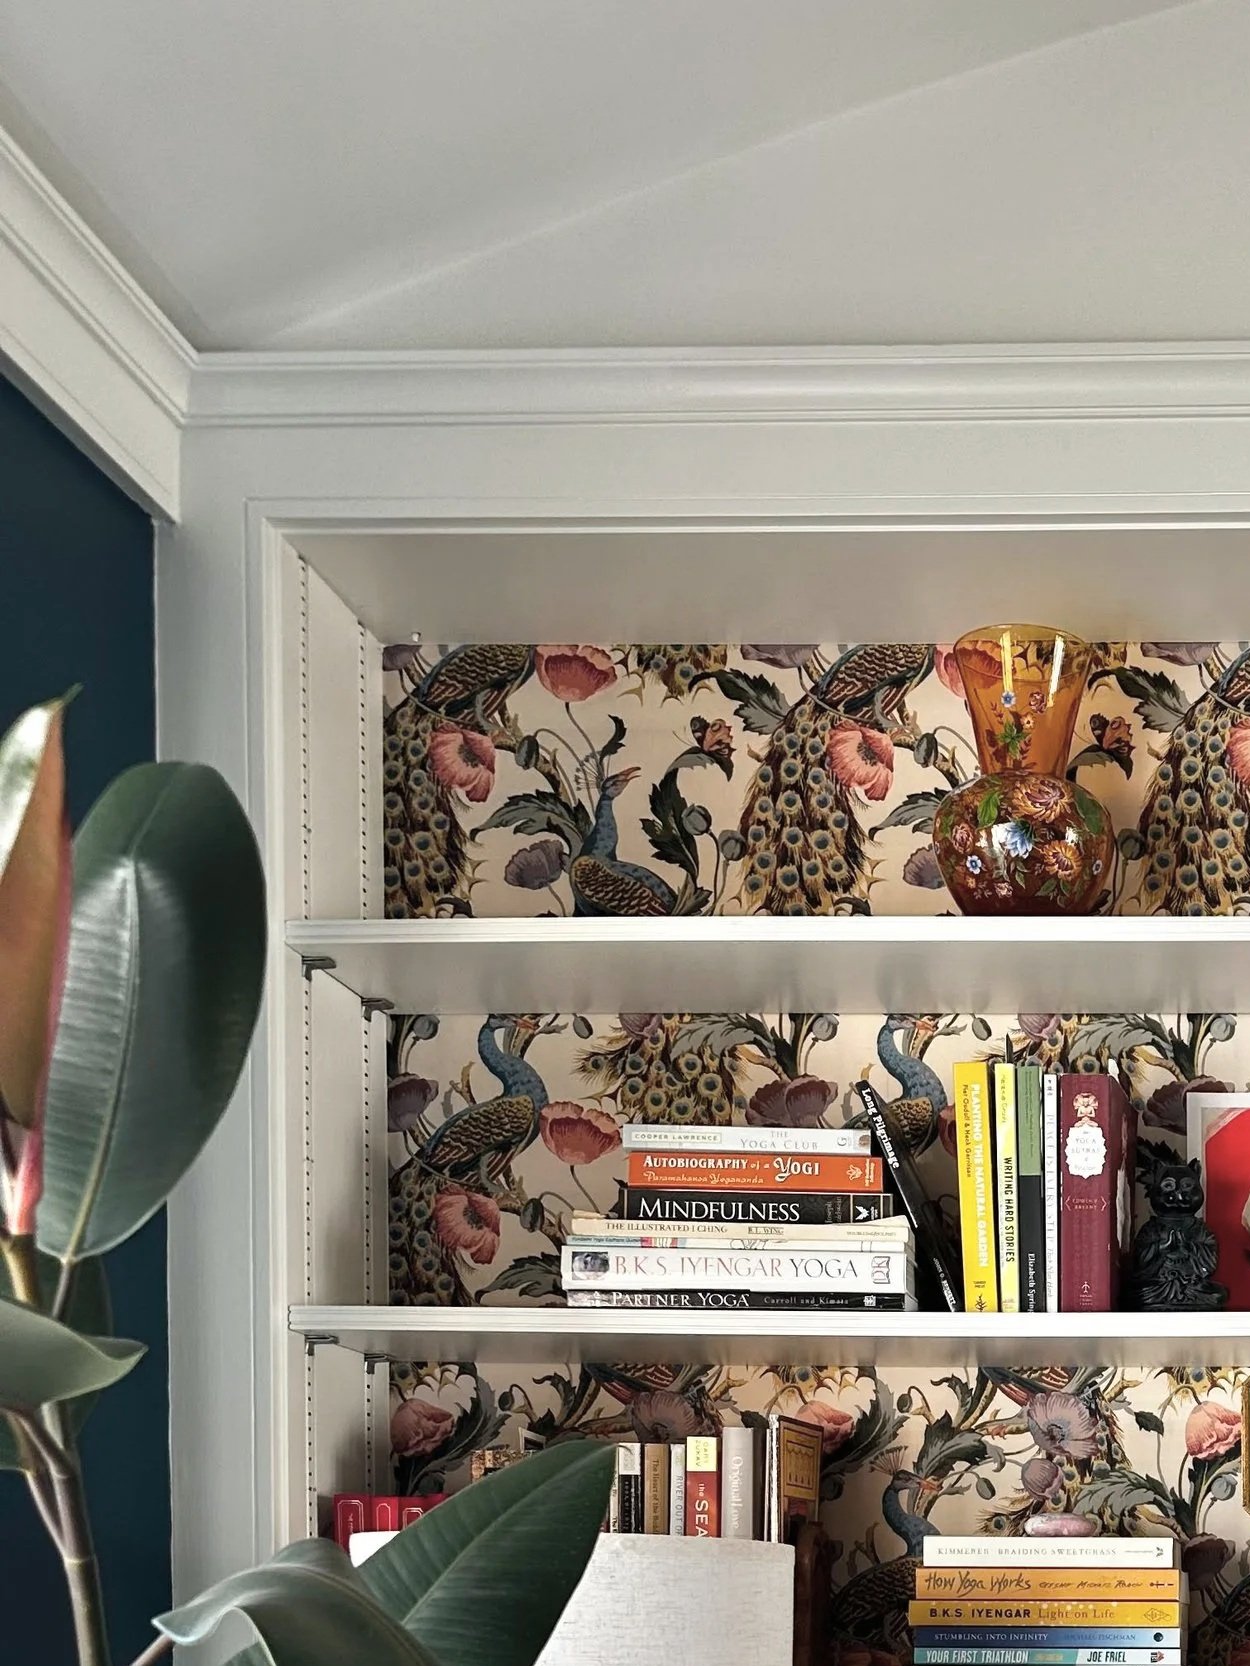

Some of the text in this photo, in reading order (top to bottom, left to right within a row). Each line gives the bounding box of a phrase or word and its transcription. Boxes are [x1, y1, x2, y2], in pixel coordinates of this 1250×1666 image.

[862, 1088, 900, 1169] Long Pilgrimage
[741, 1139, 818, 1150] YOGA CLUB
[643, 1155, 759, 1170] AUTOBIOGRAPHY of
[709, 1173, 764, 1184] Yogananda
[971, 1084, 989, 1267] PLANTING THE NATURAL GARDEN
[639, 1197, 800, 1222] MINDFULNESS
[1003, 1157, 1015, 1262] WRITING HARD STORIES
[628, 1223, 689, 1232] ILLUSTRATED
[697, 1225, 728, 1233] CHING
[615, 1256, 857, 1278] B.K.S. IYENGAR YOGA
[611, 1291, 749, 1307] PARTNER YOGA
[729, 1456, 743, 1502] Original
[675, 1525, 683, 1535] OF
[938, 1548, 1116, 1556] KIMMERER BRAIDING SWEETGRASS
[925, 1571, 1031, 1598] How Yoga Works
[972, 1609, 1031, 1618] IYENGAR
[1038, 1609, 1068, 1621] Light
[1093, 1609, 1115, 1619] Life
[935, 1633, 1048, 1641] STUMBLING INTO INFINITY
[926, 1650, 948, 1663] YOUR
[952, 1650, 978, 1663] FIRST
[981, 1650, 1028, 1664] TRIATHLON
[1087, 1651, 1103, 1662] JOE
[1105, 1651, 1126, 1663] FRIEL
